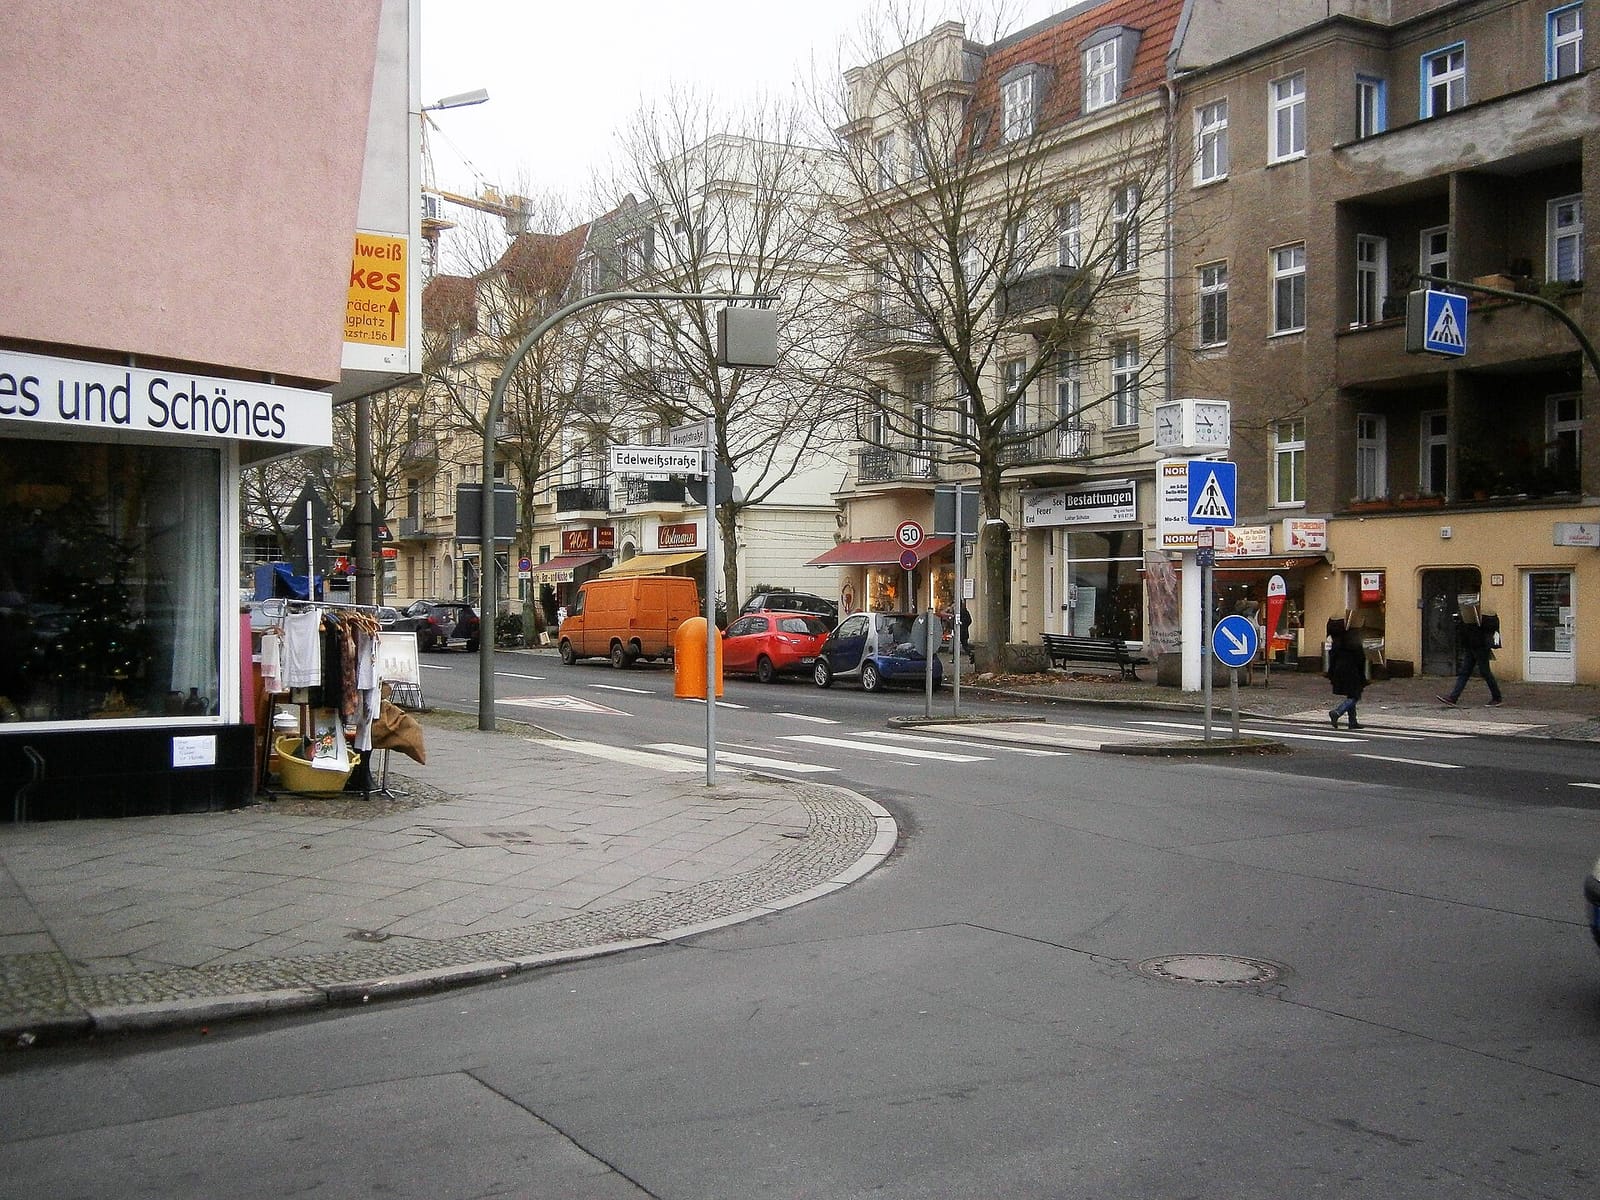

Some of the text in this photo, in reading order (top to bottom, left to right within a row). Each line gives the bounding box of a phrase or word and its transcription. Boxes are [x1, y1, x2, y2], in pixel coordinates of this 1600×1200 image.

[350, 260, 401, 292] kes
[0, 373, 286, 438] es und Schönes
[617, 453, 696, 468] Edelweißstraße
[1165, 467, 1187, 475] NOR
[1067, 492, 1132, 507] Bestattungen
[902, 528, 918, 541] 50
